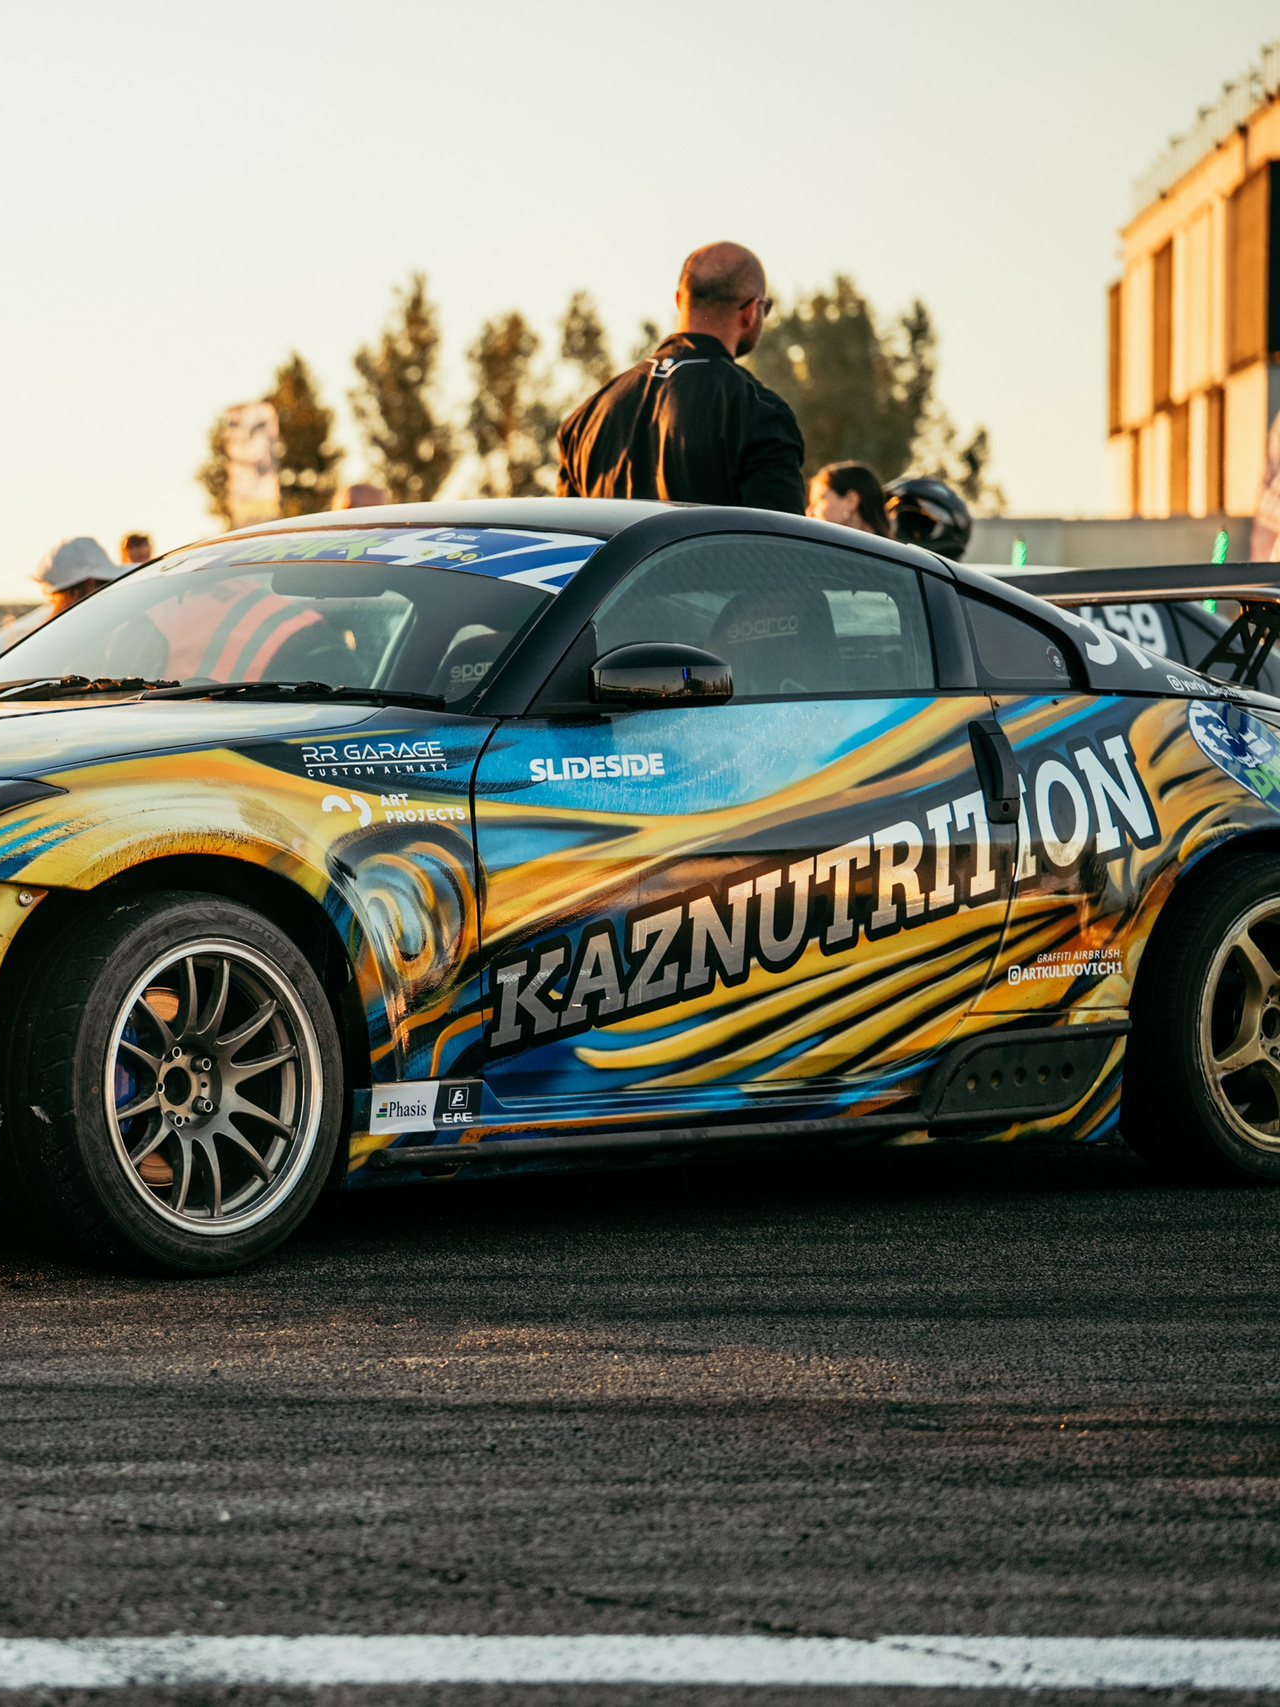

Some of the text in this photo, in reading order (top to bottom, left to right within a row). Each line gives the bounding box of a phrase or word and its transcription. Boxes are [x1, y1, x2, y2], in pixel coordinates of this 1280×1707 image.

[301, 740, 444, 763] RR GARAGE
[307, 763, 448, 777] CUSTOM ALMATY
[529, 752, 666, 782] SLIDESIDE
[380, 793, 409, 807] ART
[384, 807, 466, 824] PROJECTS
[490, 734, 1155, 1049] KAZNUTRITION
[1037, 948, 1124, 963] GRAFFITI AIRBRUSH:
[388, 1100, 427, 1118] Phasis
